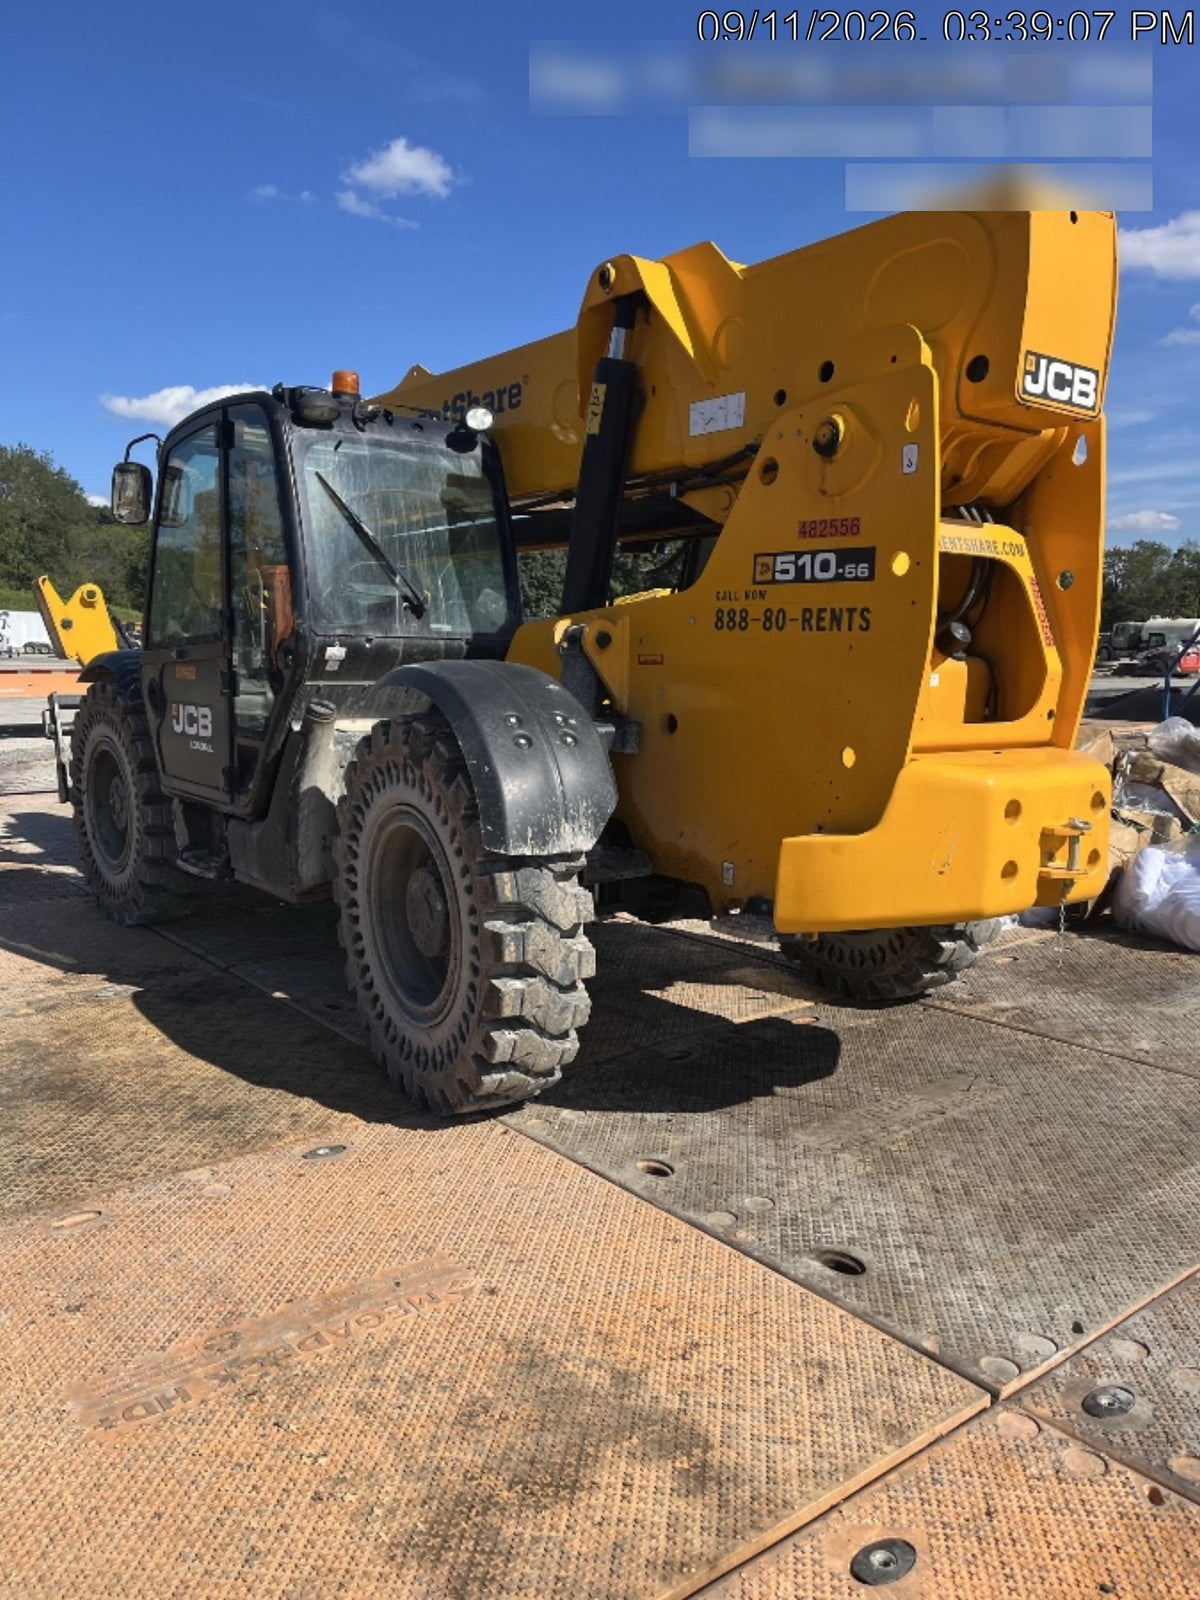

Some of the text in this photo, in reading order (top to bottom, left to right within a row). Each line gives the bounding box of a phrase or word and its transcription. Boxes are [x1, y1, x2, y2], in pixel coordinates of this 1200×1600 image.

[1024, 358, 1097, 408] JCB
[799, 517, 861, 538] 482556
[939, 536, 1026, 557] ENTSHARE.COM
[715, 589, 768, 602] CALL NOW
[714, 607, 872, 632] 888-80-RENTS
[172, 703, 212, 737] JCB
